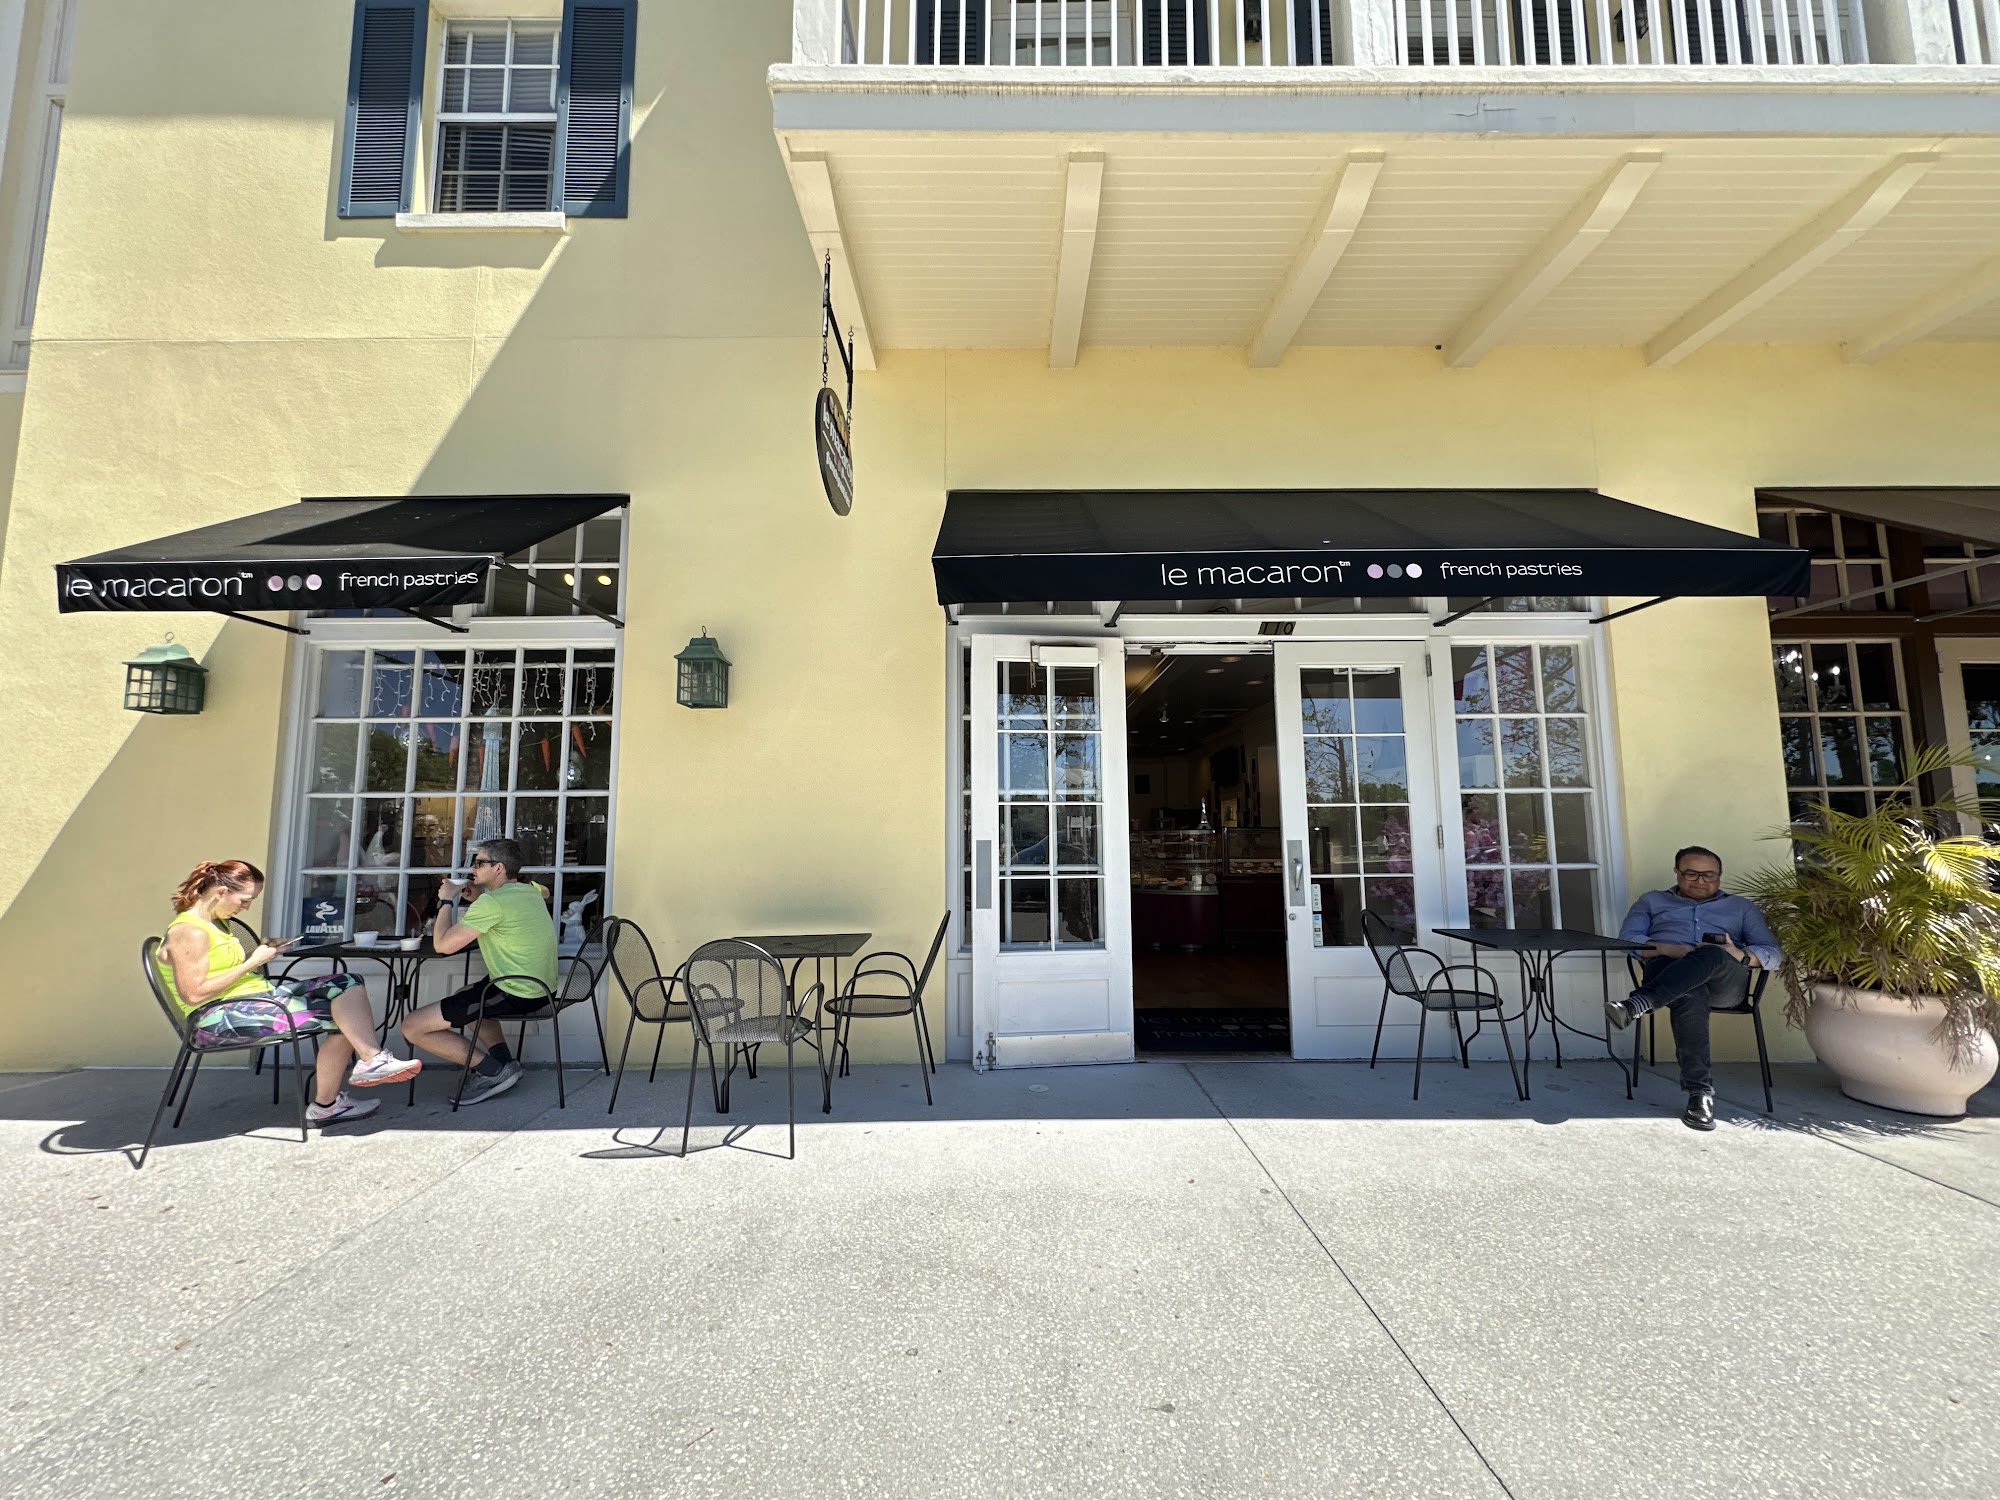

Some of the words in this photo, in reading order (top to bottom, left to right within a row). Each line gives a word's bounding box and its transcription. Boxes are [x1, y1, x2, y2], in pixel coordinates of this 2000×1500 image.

[1161, 563, 1188, 586] le
[1197, 564, 1343, 585] macaron
[1439, 561, 1502, 580] french
[1505, 562, 1583, 579] pastries
[65, 574, 93, 598] le
[101, 577, 243, 598] macaron
[339, 572, 399, 591] french
[403, 571, 479, 590] pastries
[1262, 622, 1294, 635] 110
[305, 922, 345, 934] LAVAZZA
